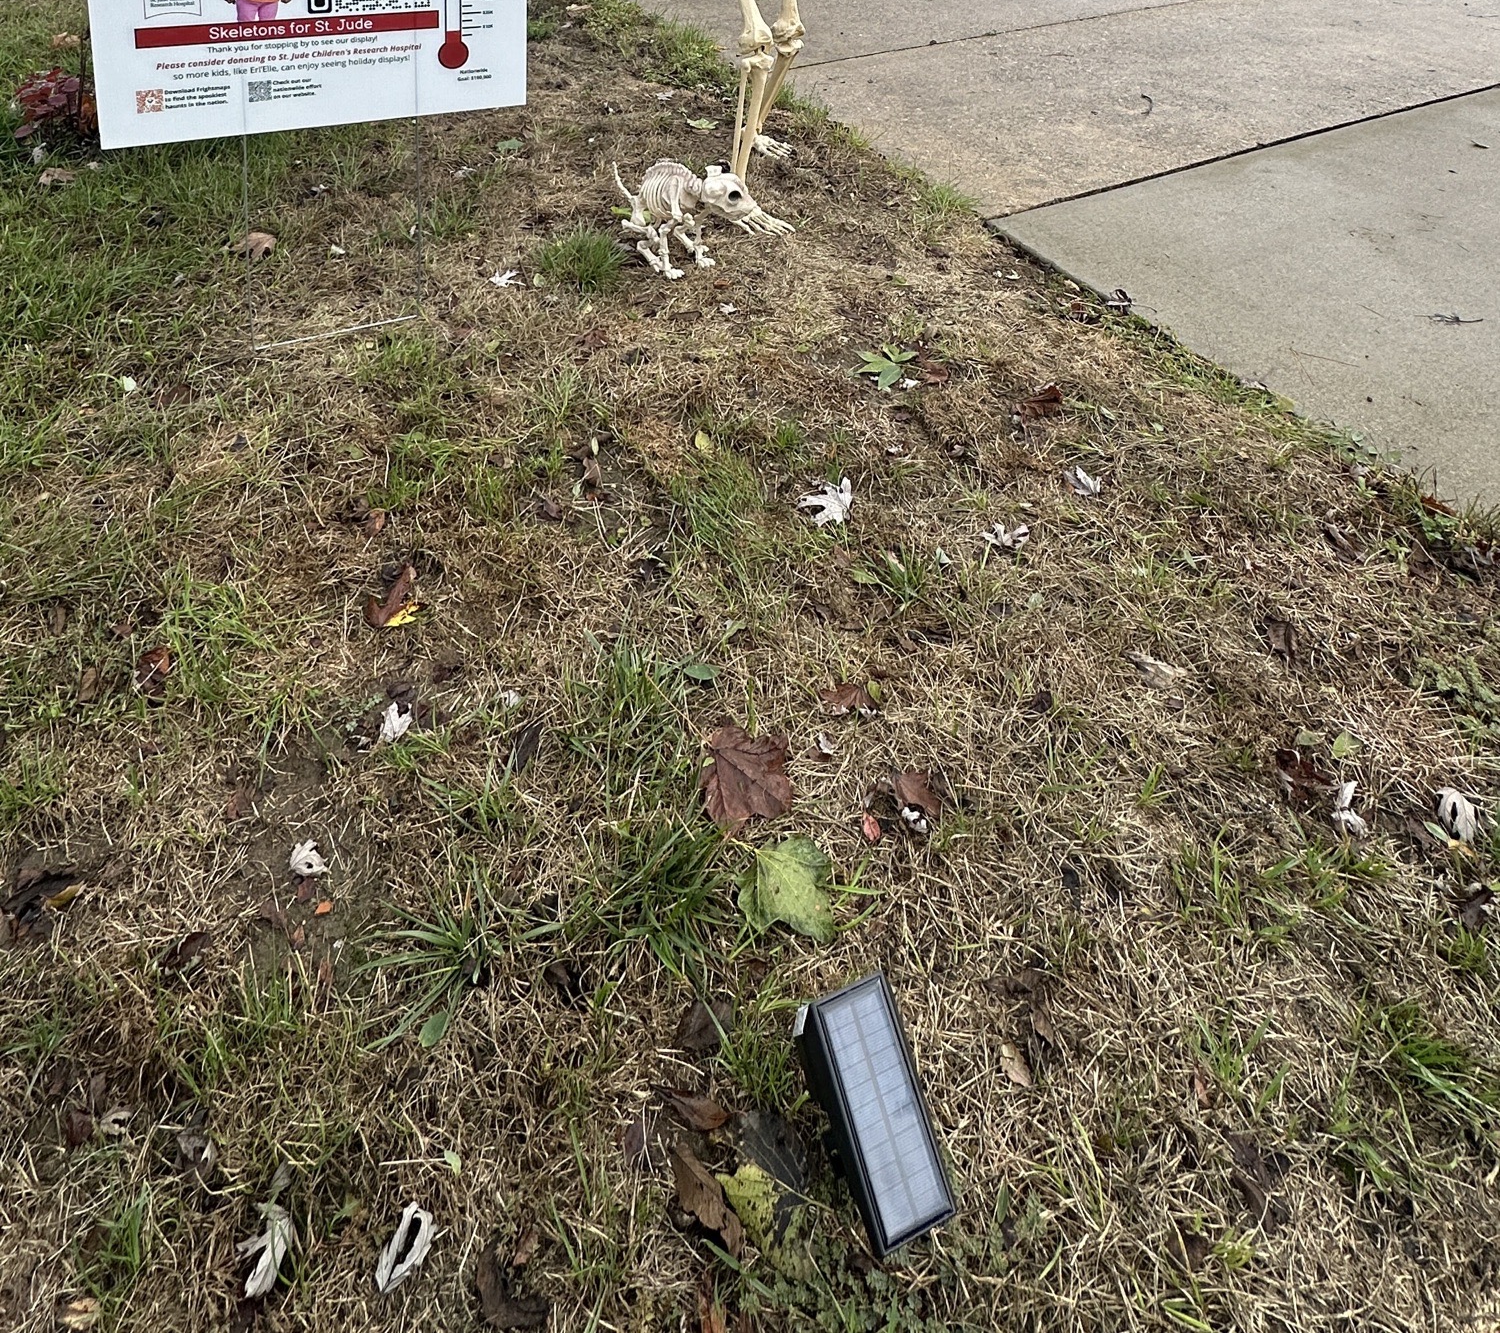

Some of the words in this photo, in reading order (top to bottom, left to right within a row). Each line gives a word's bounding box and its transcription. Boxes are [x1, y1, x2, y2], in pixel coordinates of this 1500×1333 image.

[209, 26, 285, 40] Skeletons
[289, 22, 311, 34] for
[315, 20, 333, 32] St.
[336, 18, 373, 31] Jude
[264, 41, 299, 50] stopping
[351, 35, 378, 44] display!
[156, 62, 185, 70] Please
[188, 59, 225, 68] consider
[227, 55, 266, 65] donating
[279, 53, 289, 61] St.
[290, 51, 309, 61] Jude
[311, 49, 351, 58] Children's
[353, 47, 388, 55] Research
[390, 43, 422, 52] Hospital
[186, 71, 209, 79] more
[211, 68, 231, 77] kids,
[233, 67, 248, 75] like
[297, 62, 319, 71] enjoy
[321, 60, 346, 68] seeing
[348, 57, 376, 66] holiday
[378, 55, 410, 64] displays!
